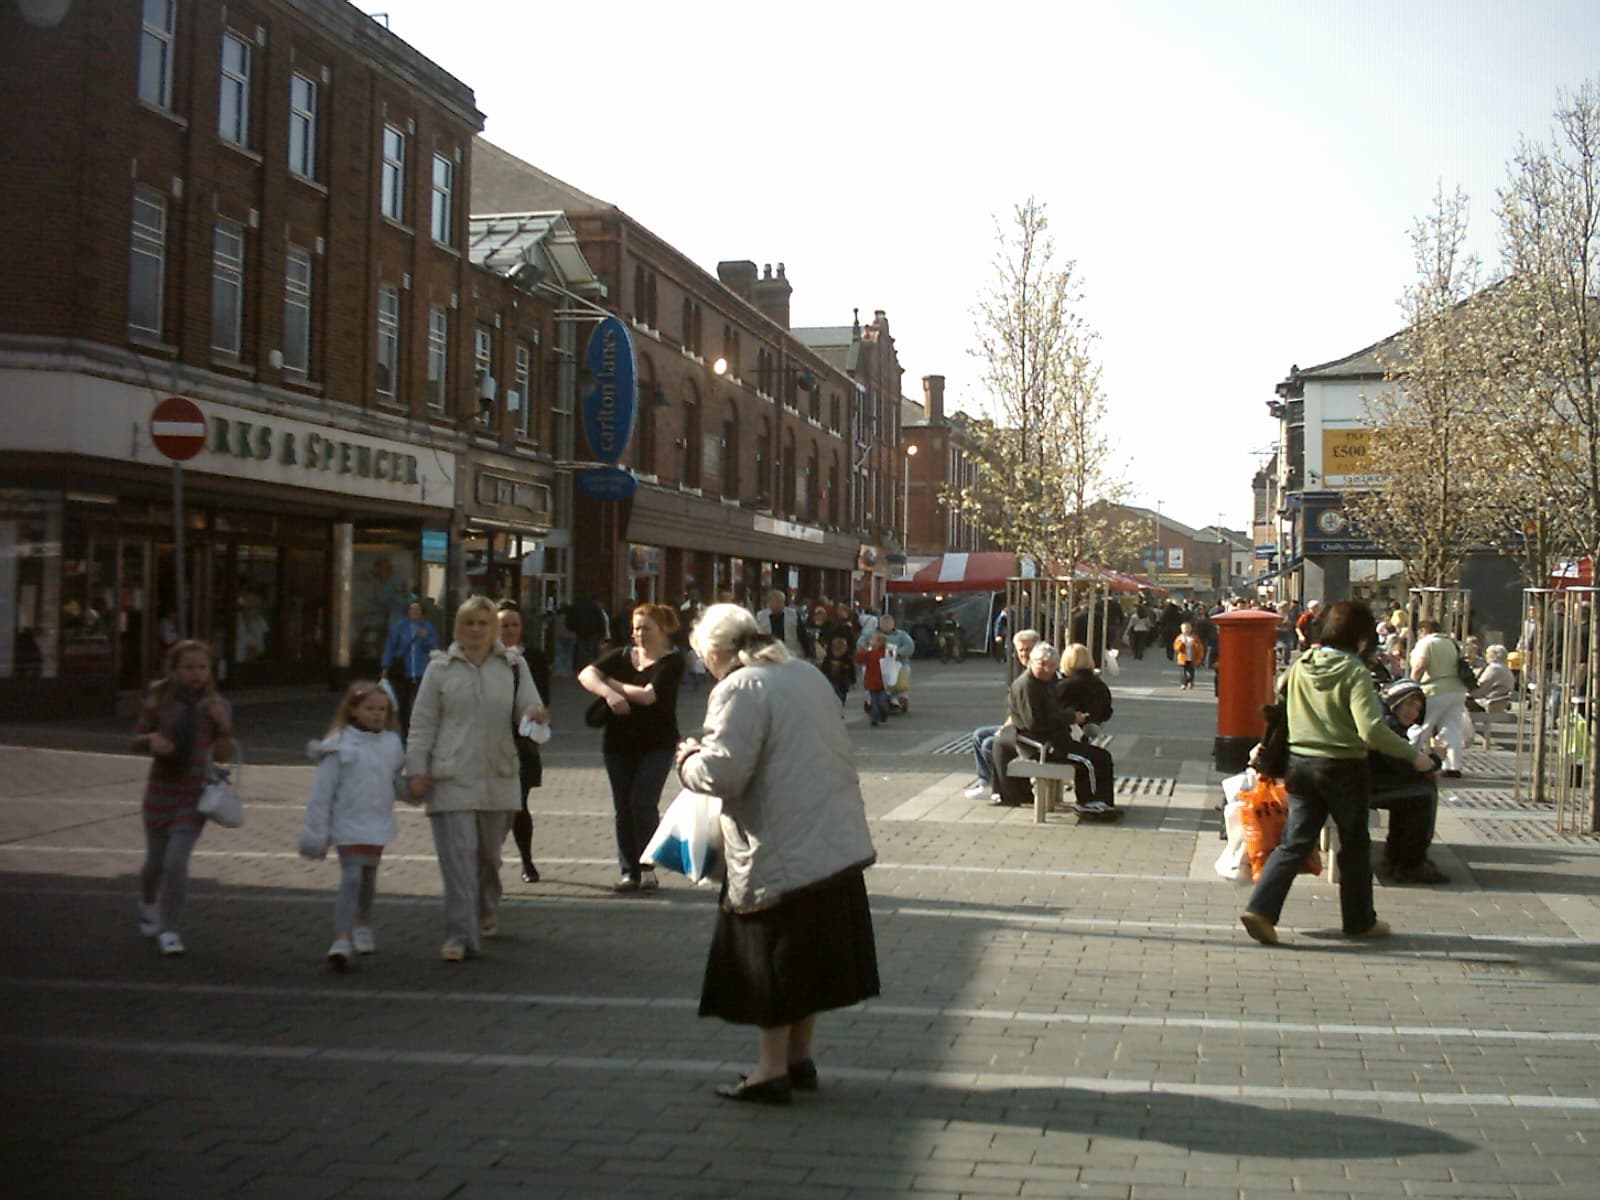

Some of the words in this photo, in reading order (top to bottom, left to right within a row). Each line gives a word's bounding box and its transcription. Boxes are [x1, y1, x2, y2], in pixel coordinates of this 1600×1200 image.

[597, 329, 617, 377] lanes
[210, 416, 272, 460] RKS
[303, 432, 419, 484] SPENCER
[596, 384, 617, 452] carlton
